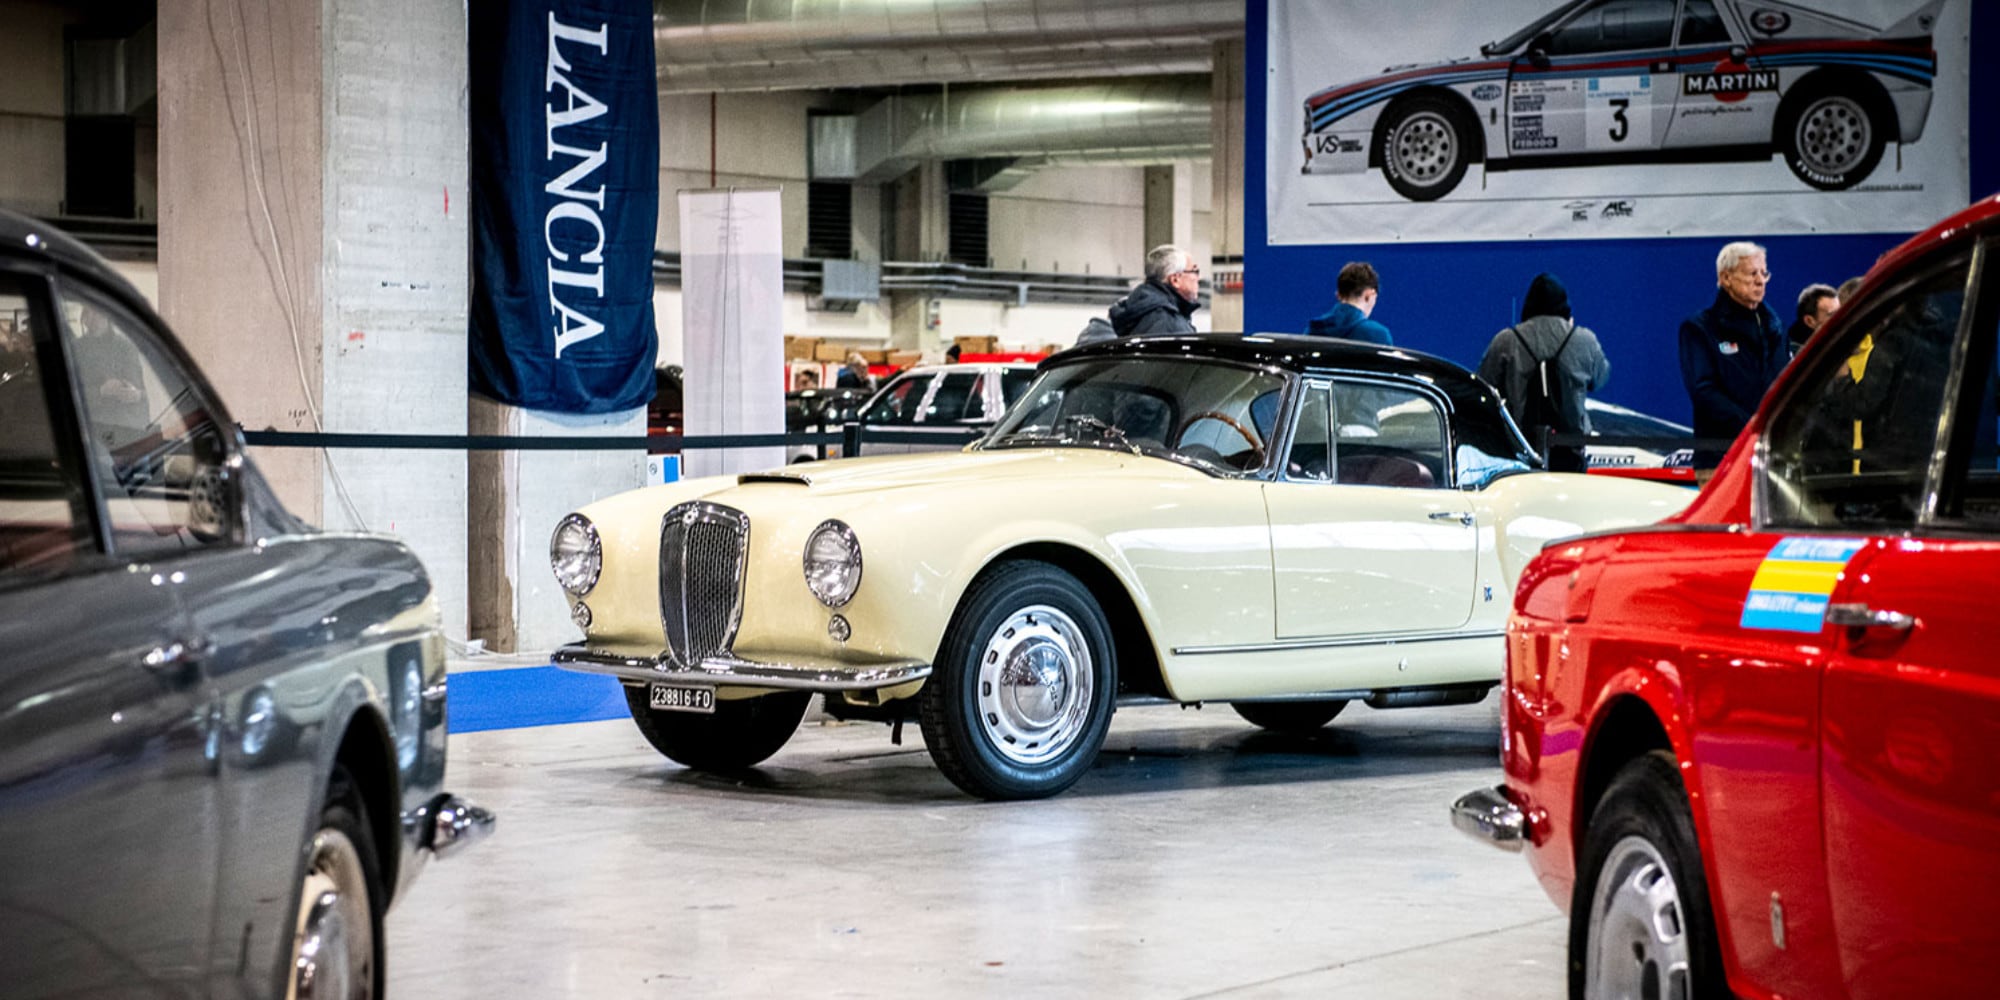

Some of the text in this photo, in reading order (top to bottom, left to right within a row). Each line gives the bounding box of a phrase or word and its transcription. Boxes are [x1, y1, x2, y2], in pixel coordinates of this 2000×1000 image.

[1687, 72, 1777, 92] MARTINI
[1609, 99, 1629, 142] 3
[545, 11, 608, 359] LANCIA
